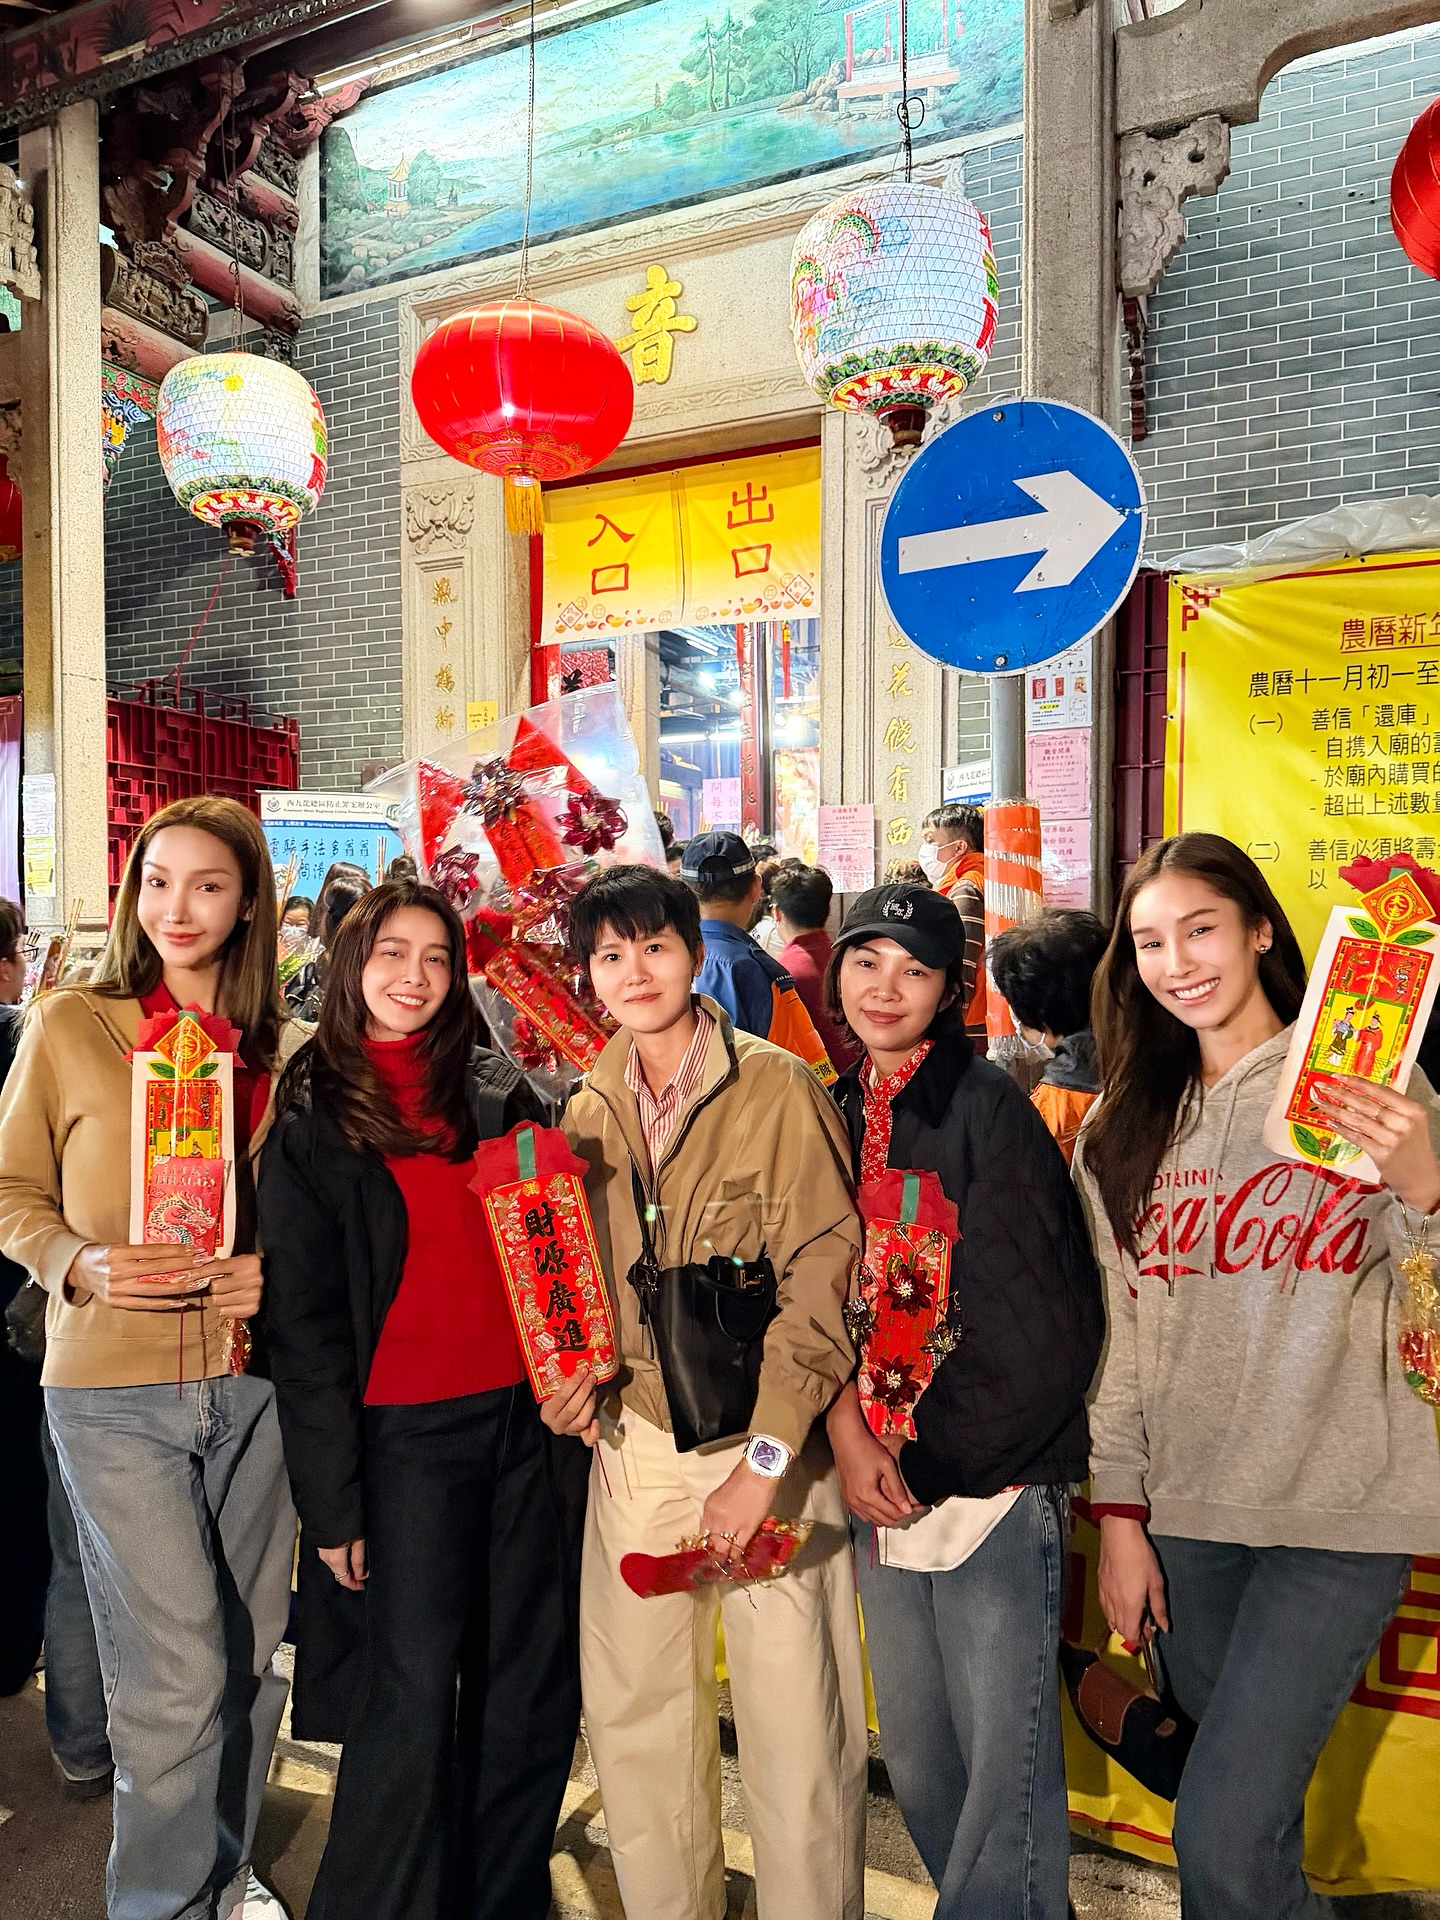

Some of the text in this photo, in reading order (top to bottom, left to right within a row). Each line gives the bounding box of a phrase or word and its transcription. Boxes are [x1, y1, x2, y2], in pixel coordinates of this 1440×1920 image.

[615, 264, 698, 385] 音
[588, 513, 636, 595] 入口
[727, 481, 774, 578] 出口
[1247, 660, 1440, 698] 農曆十一月初一至
[524, 1201, 589, 1353] 財源廣進
